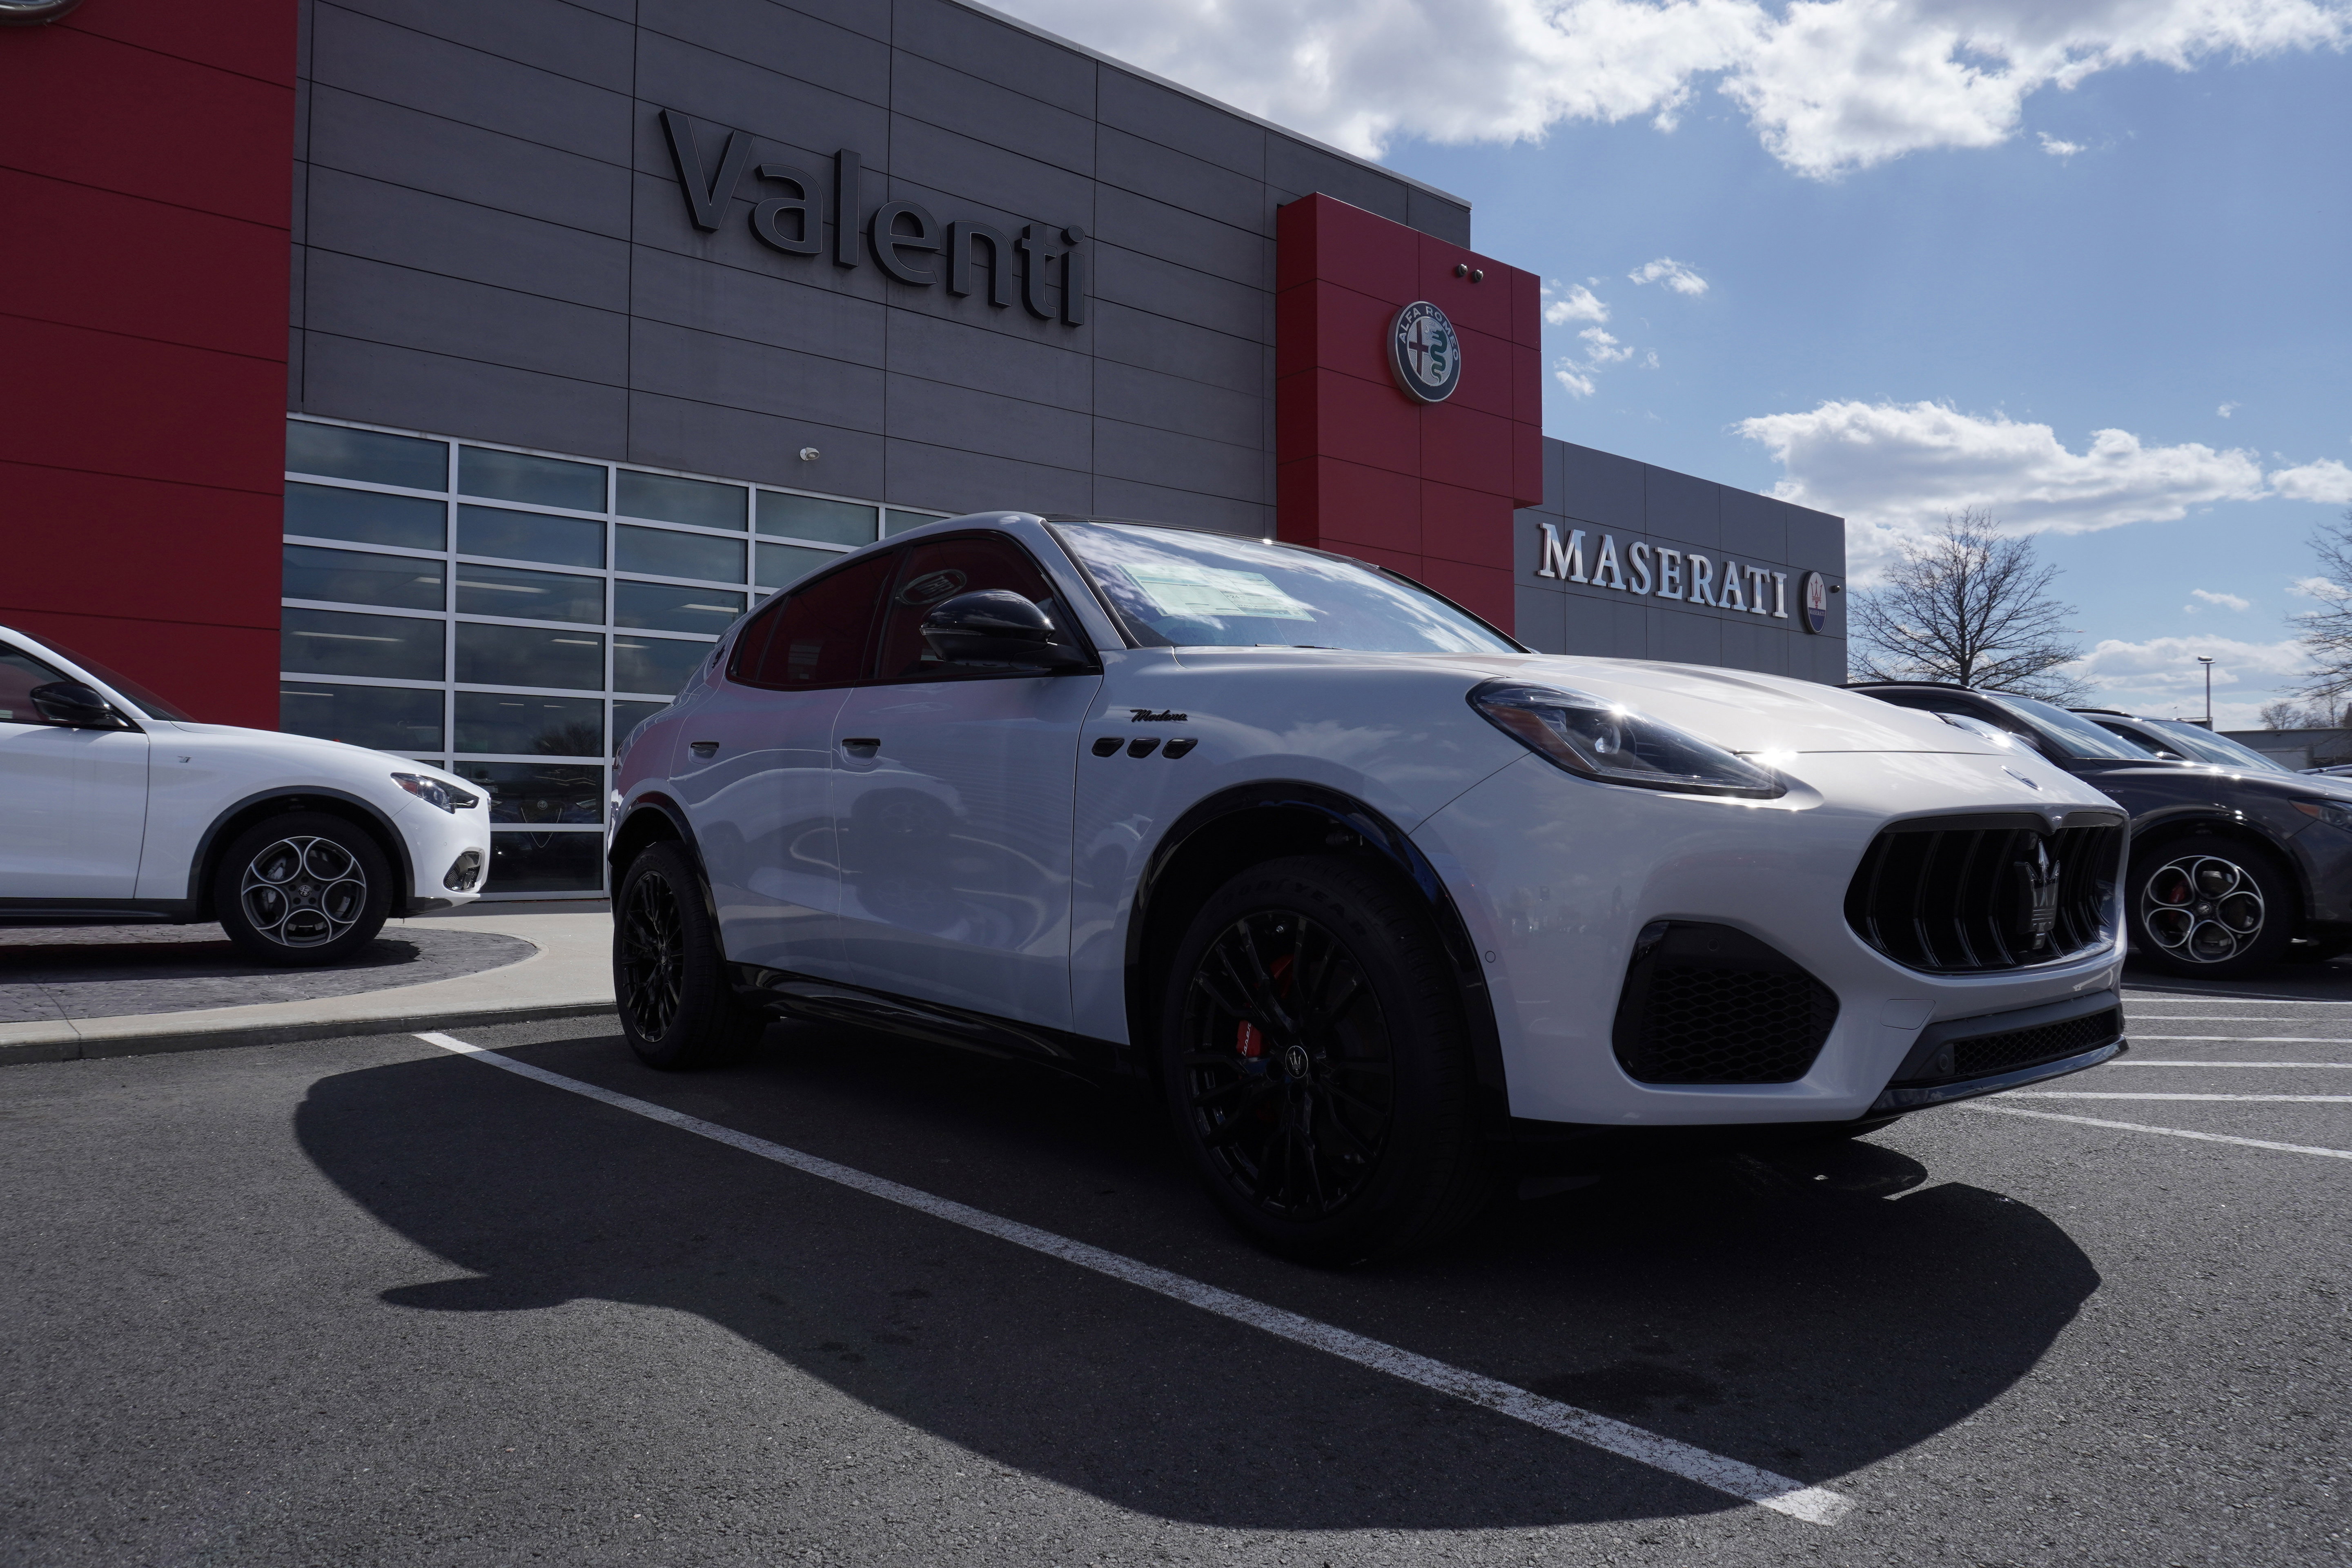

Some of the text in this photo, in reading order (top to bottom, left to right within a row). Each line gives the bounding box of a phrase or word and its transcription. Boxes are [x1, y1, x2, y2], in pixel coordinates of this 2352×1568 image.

[659, 108, 1085, 327] Valenti
[1399, 306, 1459, 361] ALFA ROMEO
[1538, 523, 1788, 618] MASERATI
[1129, 709, 1188, 722] Modena
